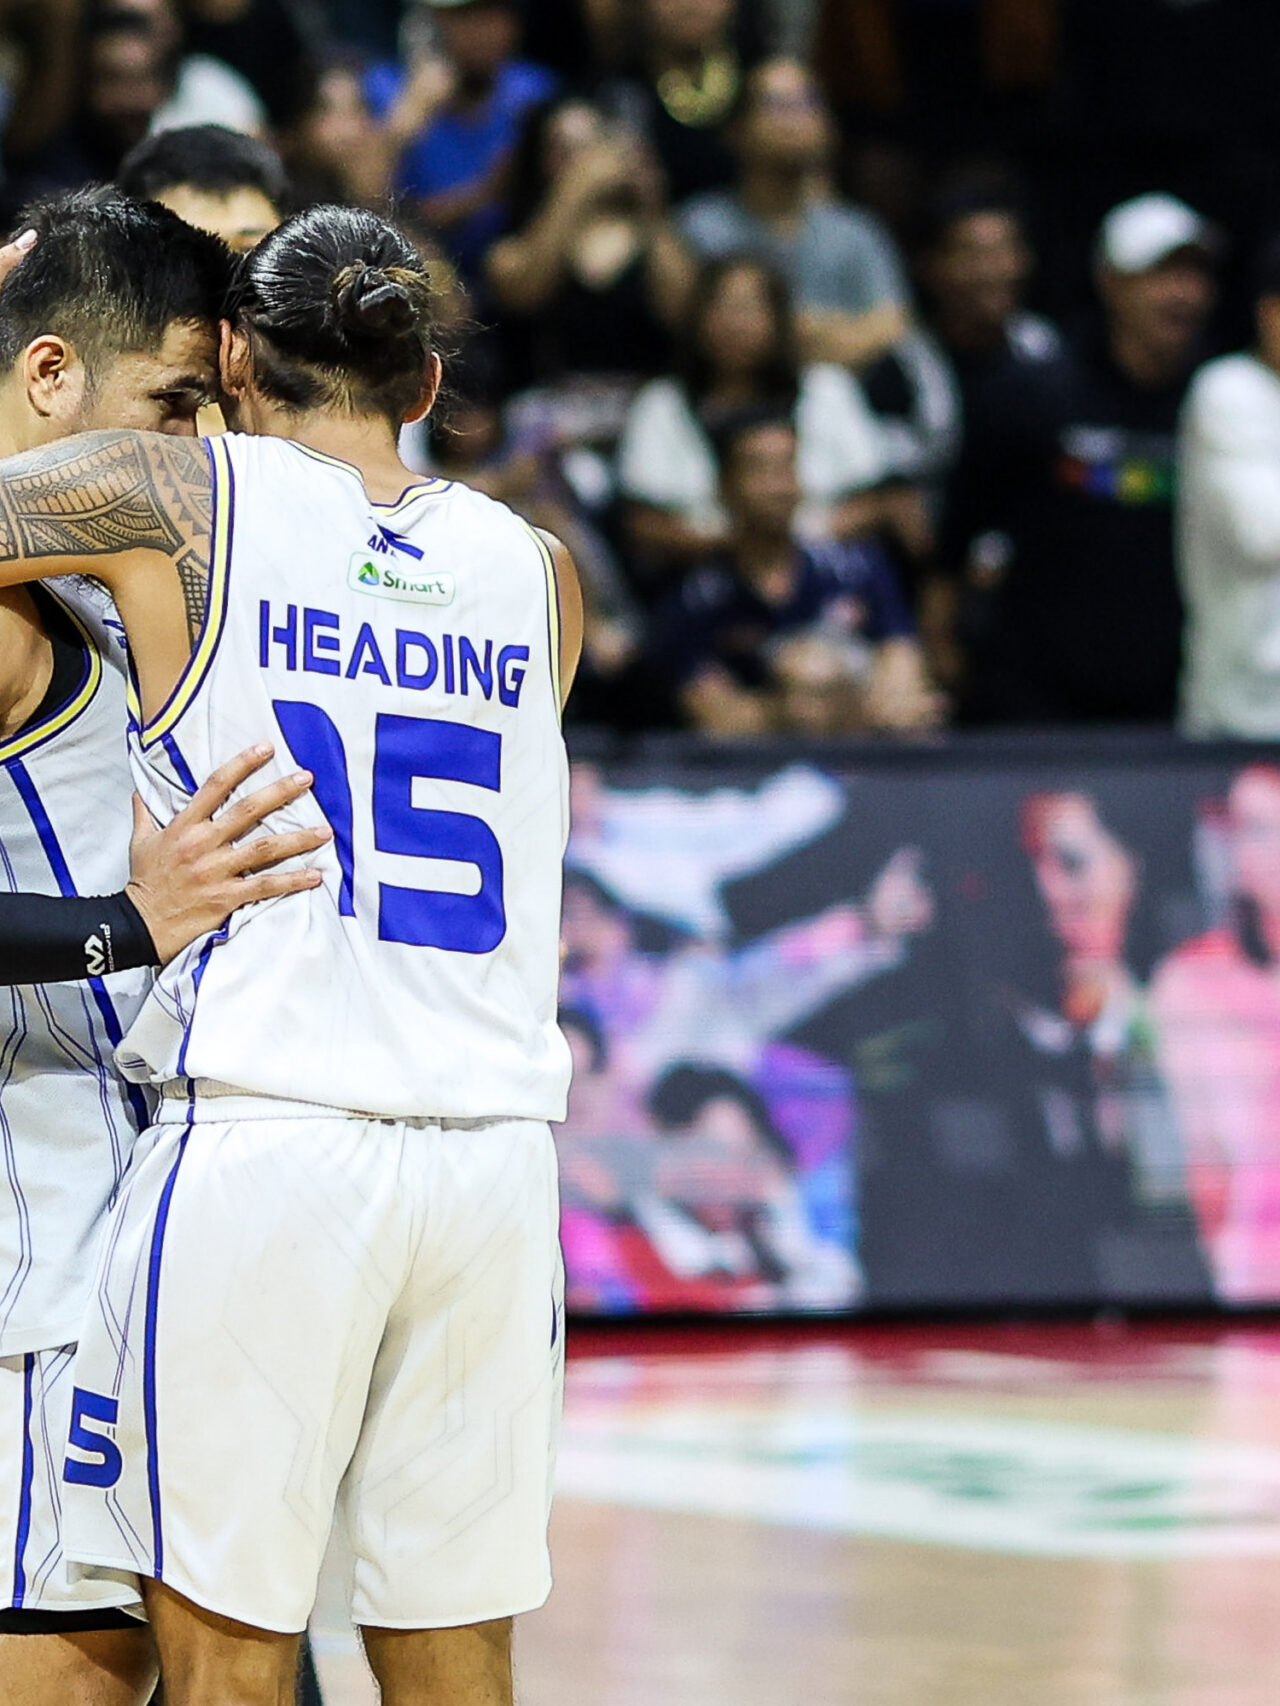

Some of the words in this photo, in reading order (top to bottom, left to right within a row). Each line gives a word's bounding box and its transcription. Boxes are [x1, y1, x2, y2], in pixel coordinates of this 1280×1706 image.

[383, 569, 446, 595] Smart
[259, 599, 530, 708] HEADING
[271, 699, 507, 954] 15
[62, 1386, 123, 1489] 5
